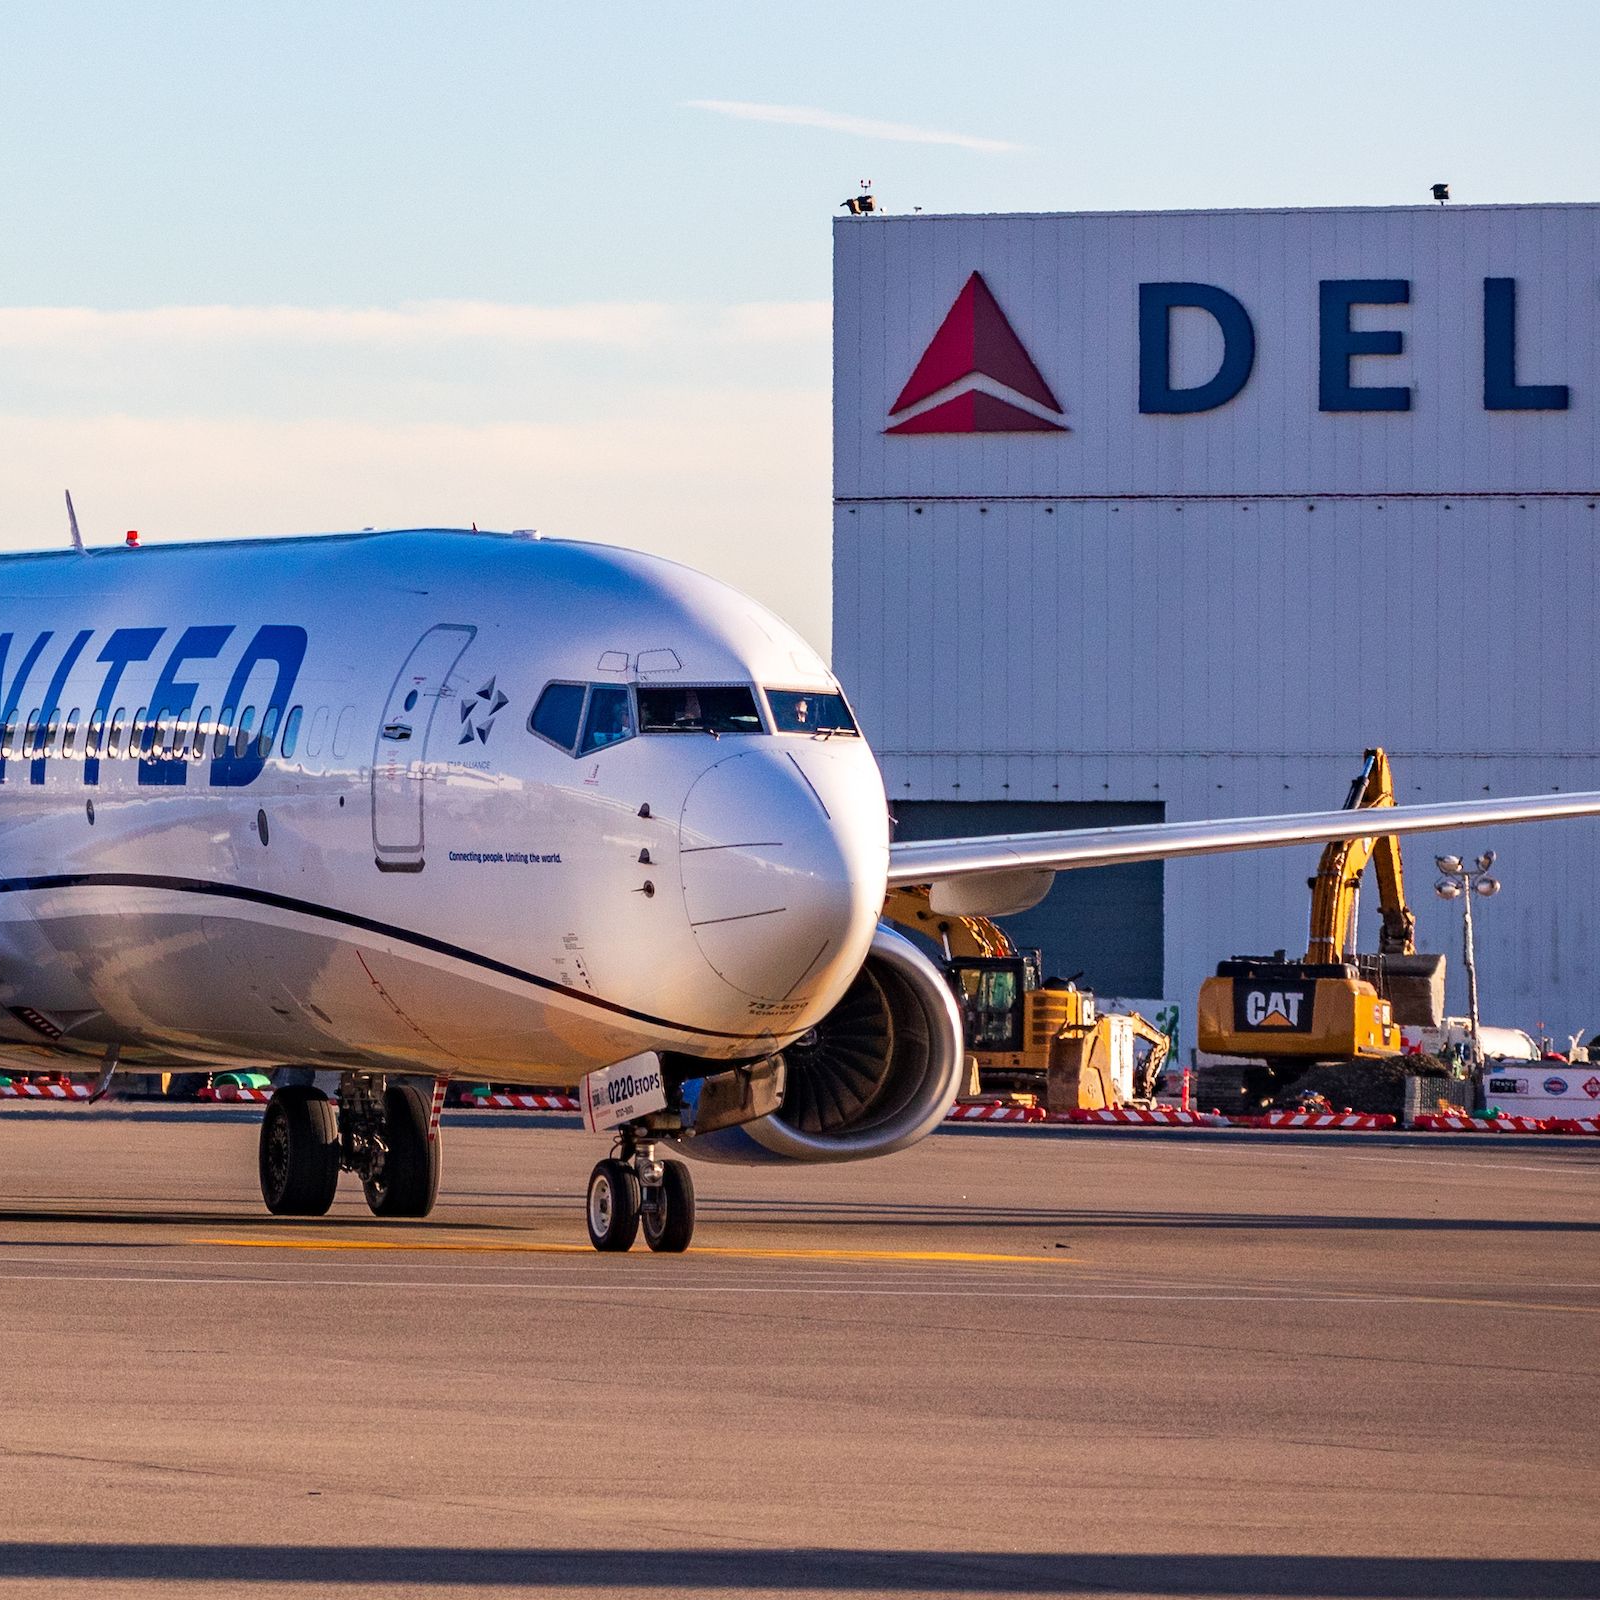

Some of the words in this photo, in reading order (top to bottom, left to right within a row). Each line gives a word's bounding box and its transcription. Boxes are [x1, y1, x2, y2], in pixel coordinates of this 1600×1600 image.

[1138, 277, 1569, 414] DEL
[449, 851, 481, 863] Connecting
[482, 853, 504, 863] people.
[505, 853, 528, 864] Uniting
[529, 853, 540, 863] the
[541, 853, 562, 863] world.
[748, 1001, 809, 1011] 737-800
[1246, 991, 1304, 1027] CAT
[608, 1074, 634, 1105] 0220
[634, 1072, 660, 1096] ETOPS
